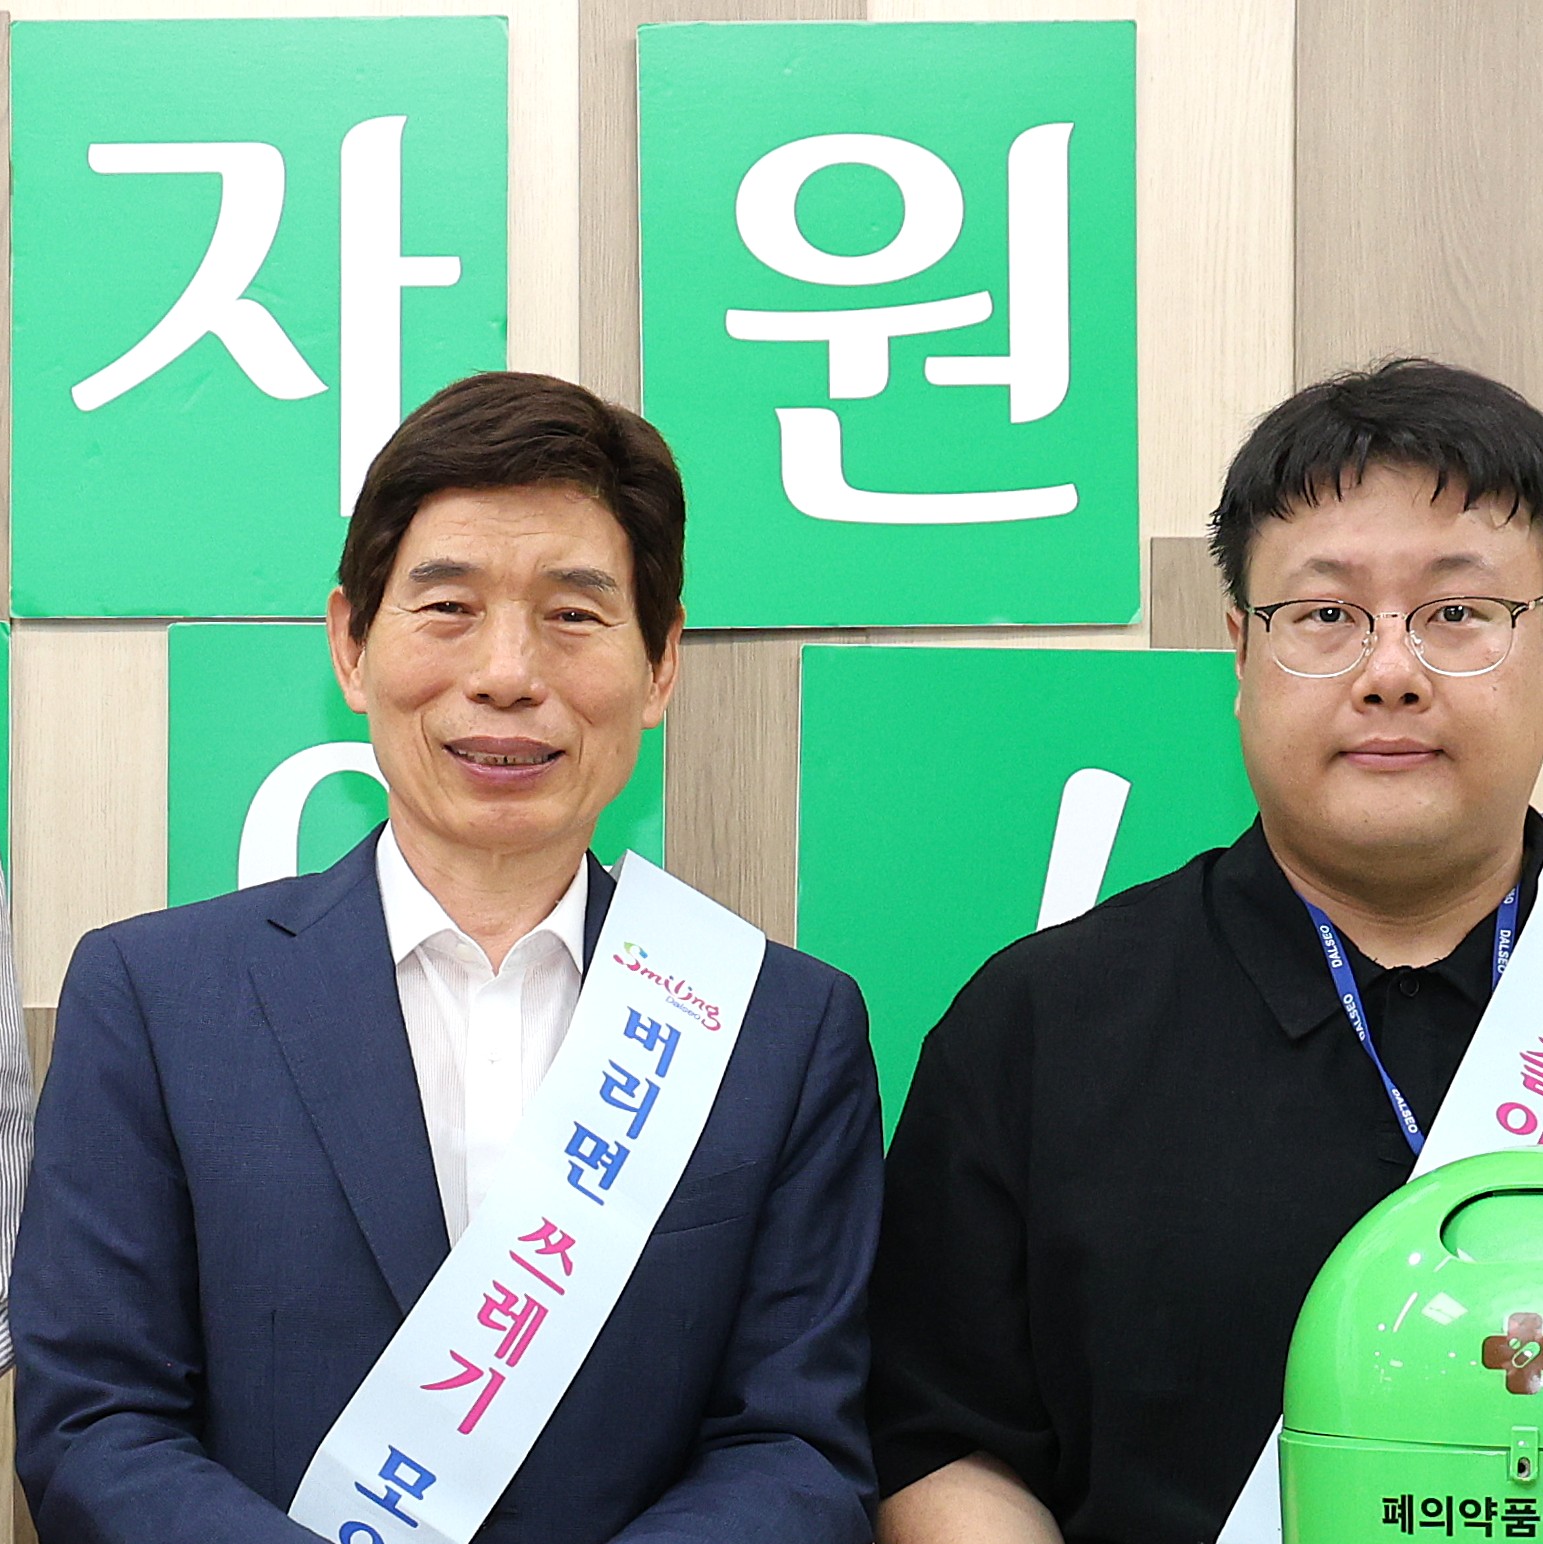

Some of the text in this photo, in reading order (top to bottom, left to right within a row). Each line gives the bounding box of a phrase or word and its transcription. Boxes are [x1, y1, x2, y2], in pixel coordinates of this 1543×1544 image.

[1319, 924, 1342, 968] DALSEO
[612, 941, 723, 1032] Smiling
[1343, 993, 1367, 1041] DALSEO
[562, 1005, 682, 1207] 버리면
[1391, 1088, 1418, 1135] DALSEO
[419, 1216, 576, 1436] 쓰레기
[1381, 1494, 1541, 1537] 폐의약품
